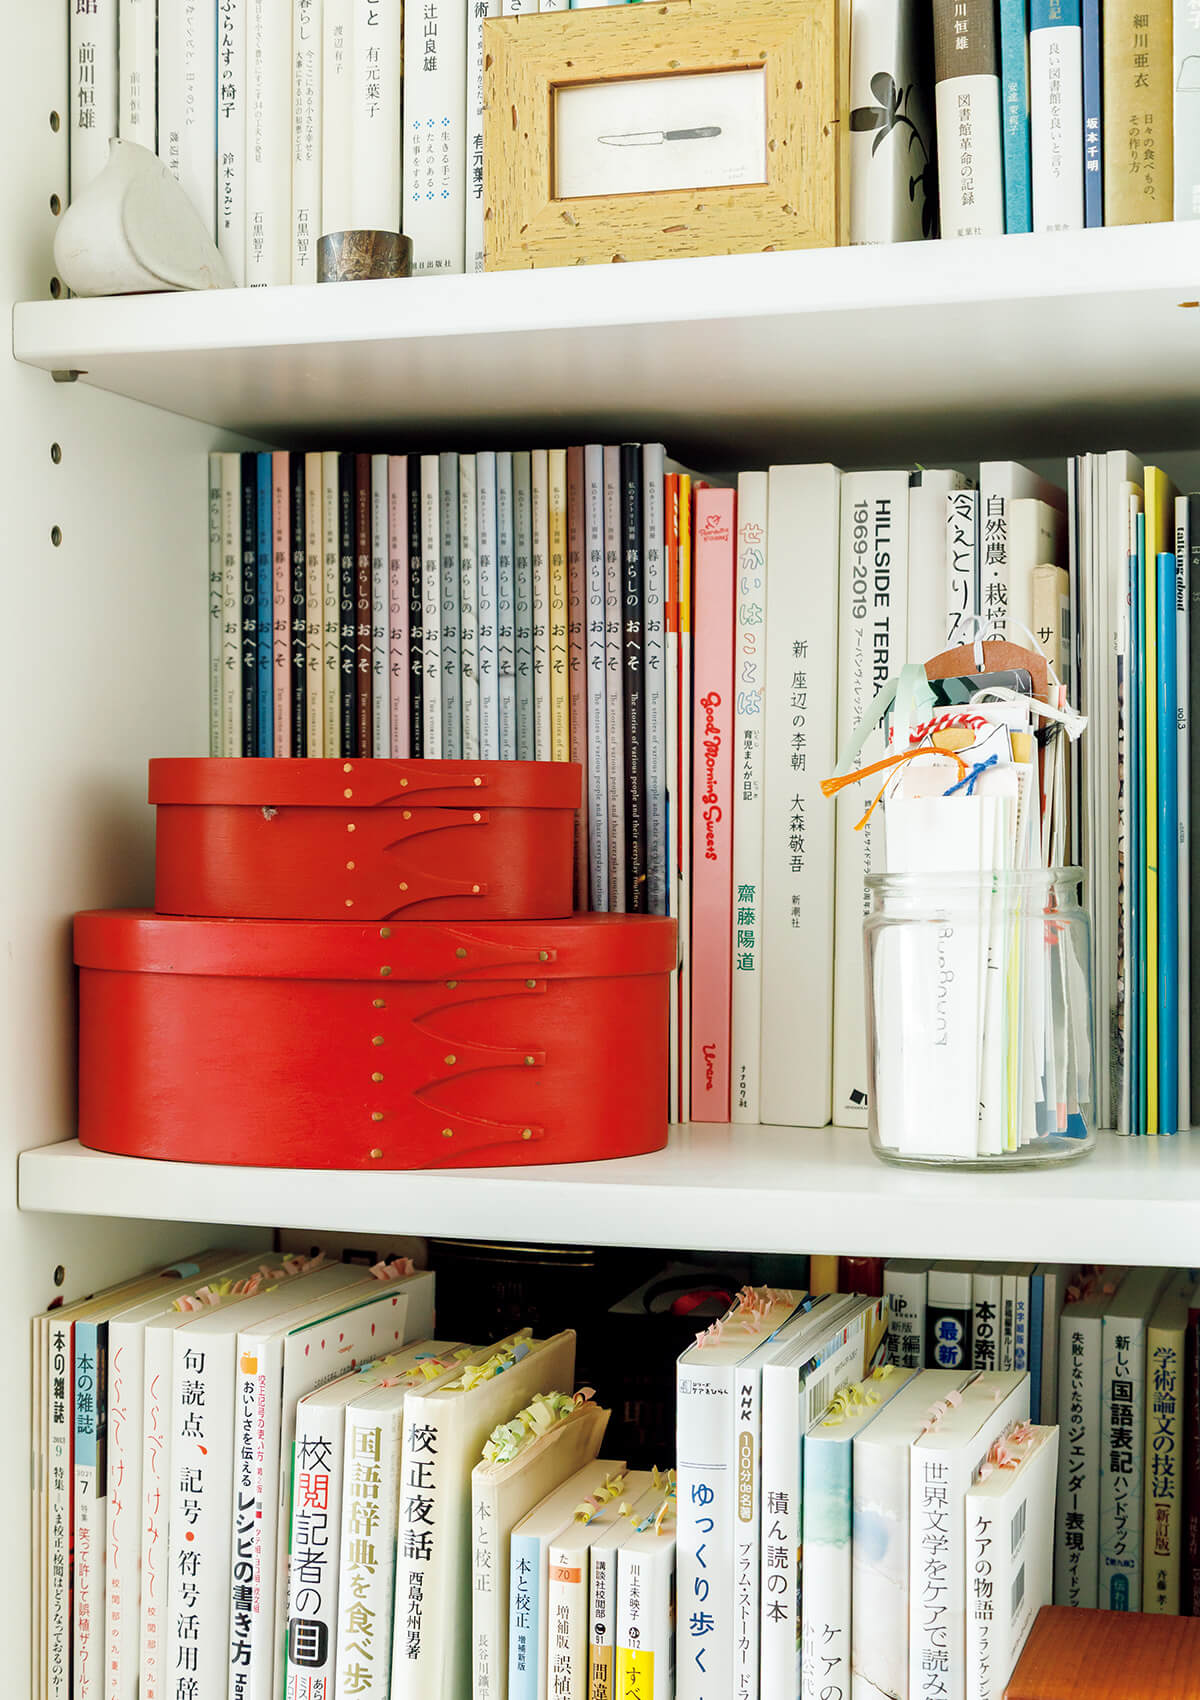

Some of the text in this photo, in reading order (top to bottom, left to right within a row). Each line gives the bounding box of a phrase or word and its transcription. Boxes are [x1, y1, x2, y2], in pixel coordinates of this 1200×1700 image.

[221, 0, 236, 119] ふらんすの椅子
[365, 0, 381, 120] と 有元葉子
[422, 4, 438, 72] 辻山良雄
[1133, 14, 1150, 89] 細川亜衣
[79, 42, 97, 129] 前川恒雄
[957, 95, 977, 209] 図書館革命の記録
[1085, 117, 1099, 173] 坂本千明
[1128, 115, 1142, 176] その作り方
[297, 209, 310, 267] 石黒智子
[852, 500, 874, 621] 1969-2019
[872, 499, 897, 598] HILLSIDE
[631, 691, 639, 706] The
[631, 735, 640, 746] of
[630, 775, 640, 801] people
[701, 692, 722, 861] Good Morning Sweets
[743, 730, 753, 801] 育児まんが日記
[790, 639, 808, 929] 新 座辺の李朝 大森敬吾 新潮社
[632, 803, 640, 818] and
[632, 819, 640, 839] their
[631, 840, 640, 874] everyday
[54, 1330, 67, 1424] 本の雑誌
[935, 1318, 960, 1367] 最新
[77, 1352, 95, 1435] 本の雑誌
[243, 1381, 256, 1487] おいしさを伝える
[740, 1384, 753, 1421] NHK
[1152, 1347, 1176, 1500] 学術論文の技法
[81, 1480, 89, 1495] 7
[1109, 1335, 1134, 1556] 新しい国語表記ハンドブック
[403, 1423, 439, 1562] 校正夜話
[232, 1491, 256, 1666] レシピの書き方
[290, 1433, 333, 1669] 校閲記者の目
[474, 1500, 492, 1593] 本と校正
[557, 1566, 571, 1584] 70
[561, 1554, 570, 1565] た
[689, 1483, 715, 1673] ゆっくり歩く
[767, 1491, 790, 1624] 積ん読の本
[921, 1461, 950, 1700] 世界文学をケアで読み
[974, 1518, 995, 1621] ケアの物語
[515, 1558, 532, 1633] 本と校正
[595, 1561, 607, 1620] 講談社校閲部
[629, 1565, 641, 1622] 川上未映子
[738, 1542, 753, 1665] ブラム・ストーカー
[553, 1605, 574, 1700] 増補版 誤植
[628, 1638, 641, 1649] 112
